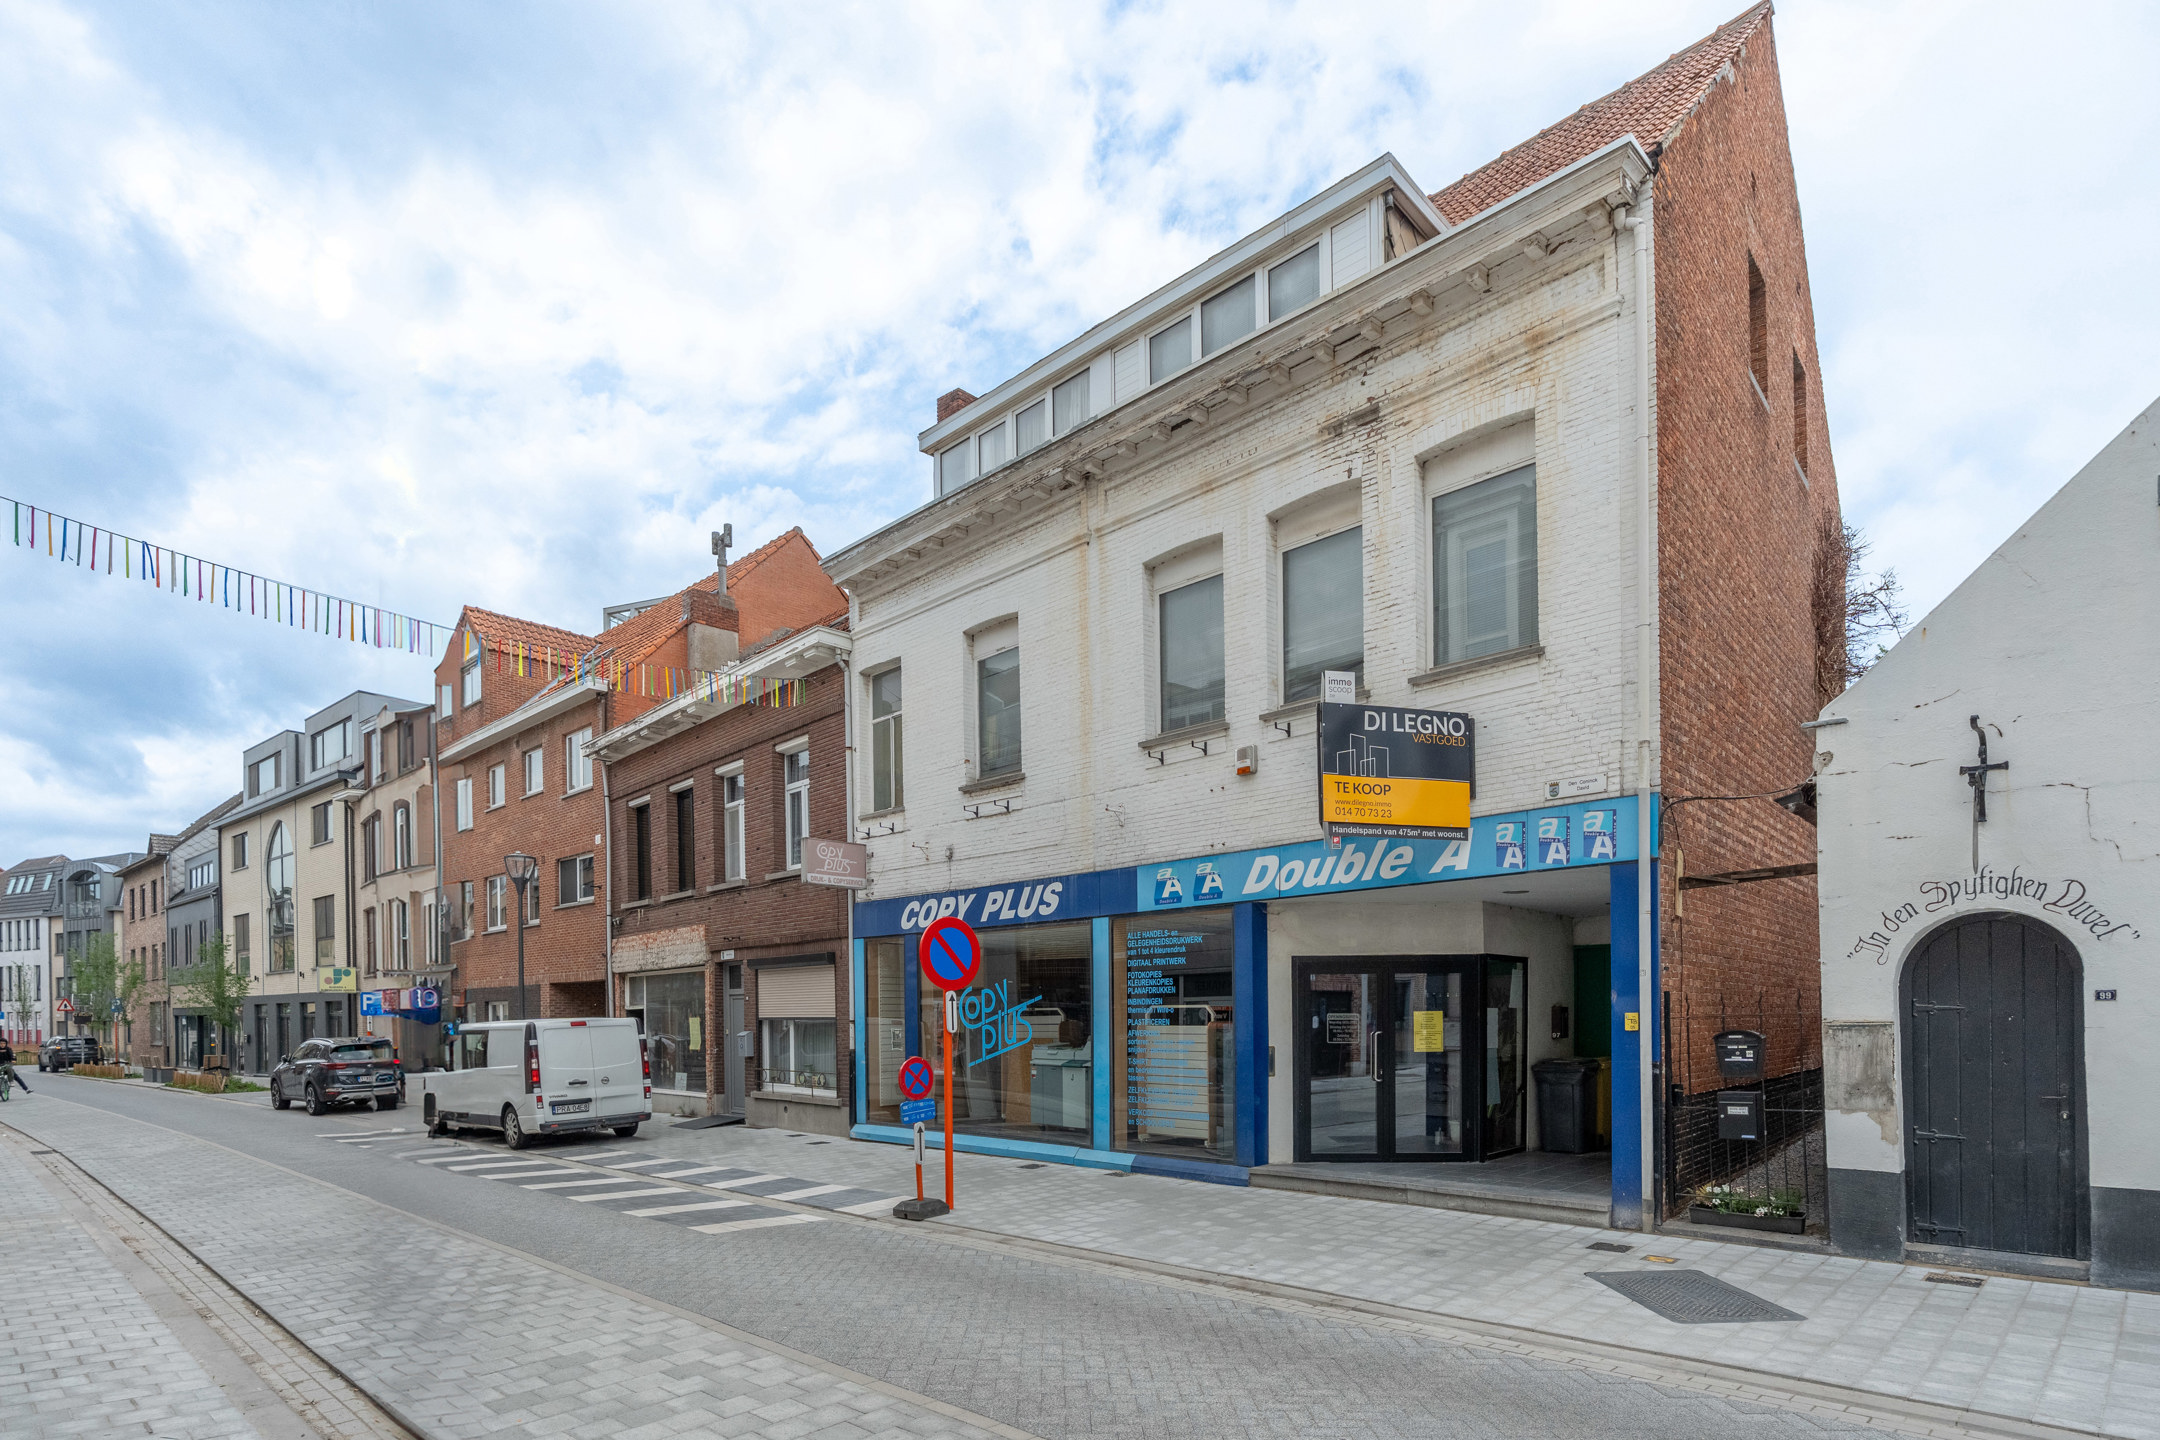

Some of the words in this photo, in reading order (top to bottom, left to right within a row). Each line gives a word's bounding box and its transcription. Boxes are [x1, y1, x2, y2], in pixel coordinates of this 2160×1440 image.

[1328, 676, 1352, 686] immo
[1328, 686, 1352, 695] scoop
[1364, 710, 1386, 731] DI
[1393, 712, 1465, 737] LEGNO
[1412, 733, 1466, 747] VASTGOED
[1335, 781, 1350, 794] TE
[1353, 783, 1391, 795] KOOP
[1335, 799, 1391, 807] www.dilegno.immo
[1335, 806, 1352, 816] 014
[1355, 807, 1366, 817] 70
[1368, 808, 1379, 818] 73
[1381, 809, 1392, 818] 23
[1332, 825, 1382, 835] Handelspand
[1422, 829, 1436, 837] met
[1242, 839, 1414, 895] Double
[1428, 828, 1473, 874] A
[901, 893, 977, 930] COPY
[980, 881, 1063, 923] PLUS
[1881, 902, 1920, 933] den
[1127, 931, 1141, 939] ALLE
[1154, 945, 1186, 954] kleurendruk
[1128, 958, 1152, 967] DIGITAAL
[1153, 957, 1187, 965] PRINTWERK
[1128, 970, 1163, 979] FOTOKOPIES
[1128, 978, 1174, 987] KLEURENKOPIES
[1128, 986, 1176, 995] PLANAFDRUKKEN
[363, 994, 375, 1011] P
[1128, 998, 1163, 1006] INBINDINGEN
